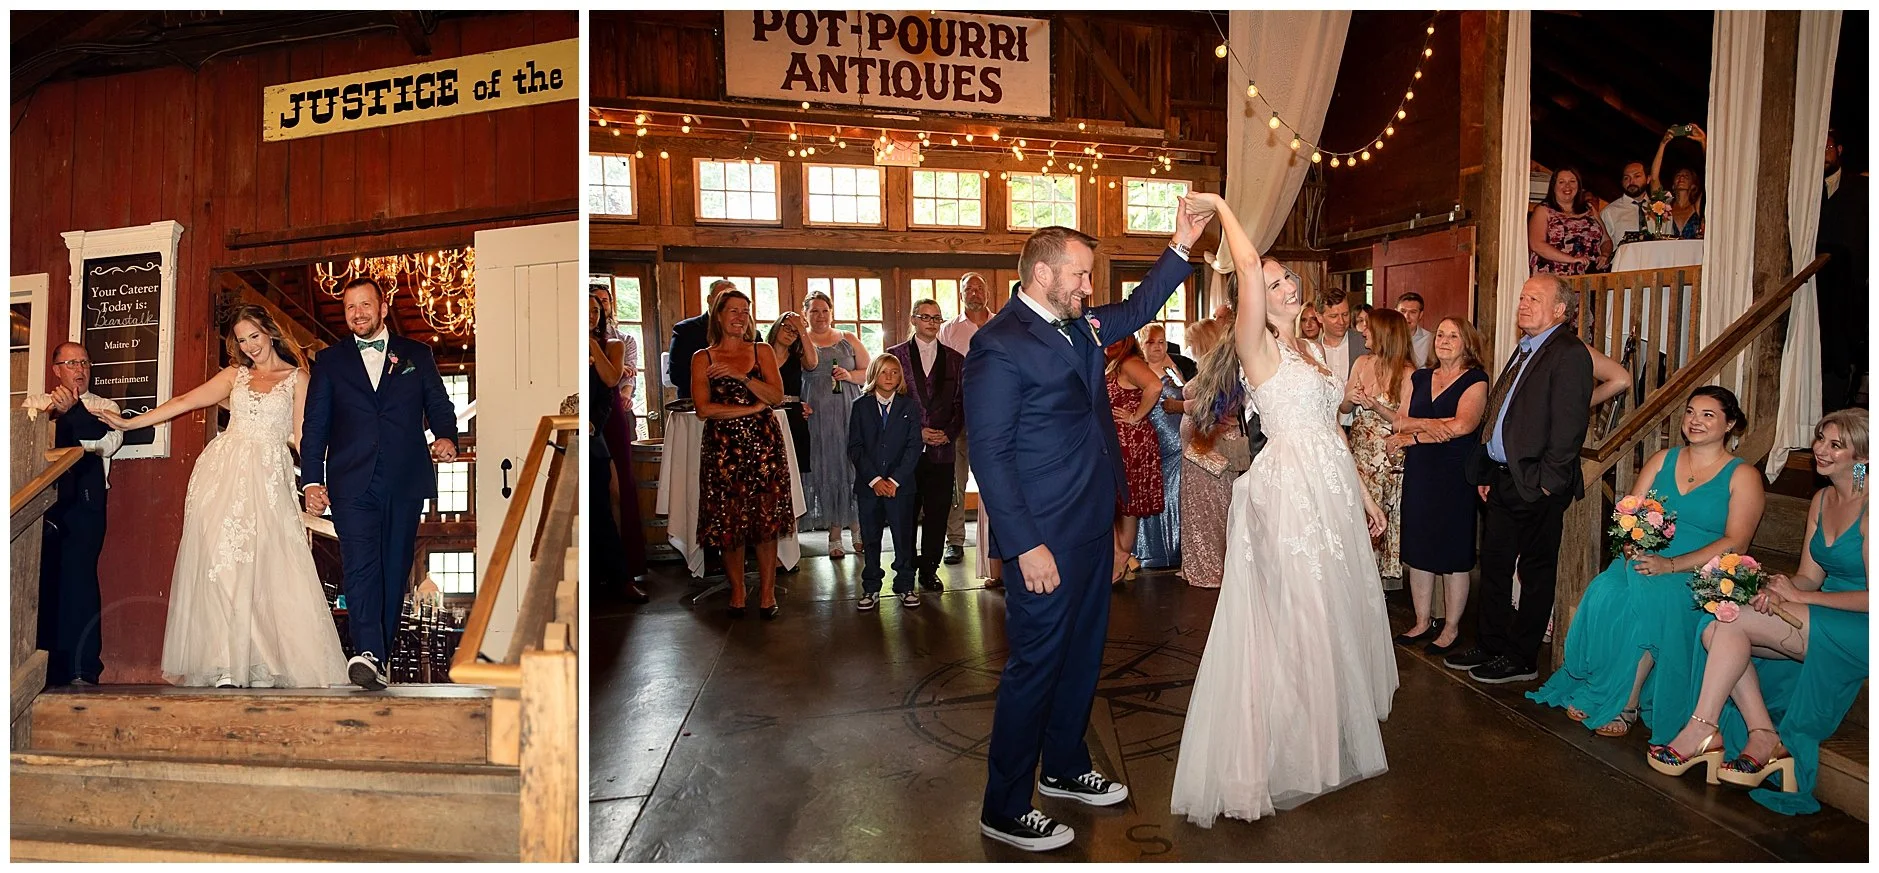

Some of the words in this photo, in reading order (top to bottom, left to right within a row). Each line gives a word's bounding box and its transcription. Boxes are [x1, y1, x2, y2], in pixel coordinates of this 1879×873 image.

[752, 10, 1029, 62] POT-POURRI
[280, 68, 459, 129] JUSTICE
[472, 69, 502, 101] of
[512, 60, 563, 95] the
[780, 52, 1003, 104] ANTIQUES
[91, 287, 117, 298] Your
[119, 284, 159, 295] Caterer
[100, 300, 133, 313] Today
[135, 299, 148, 310] is:
[94, 375, 149, 385] Entertainment
